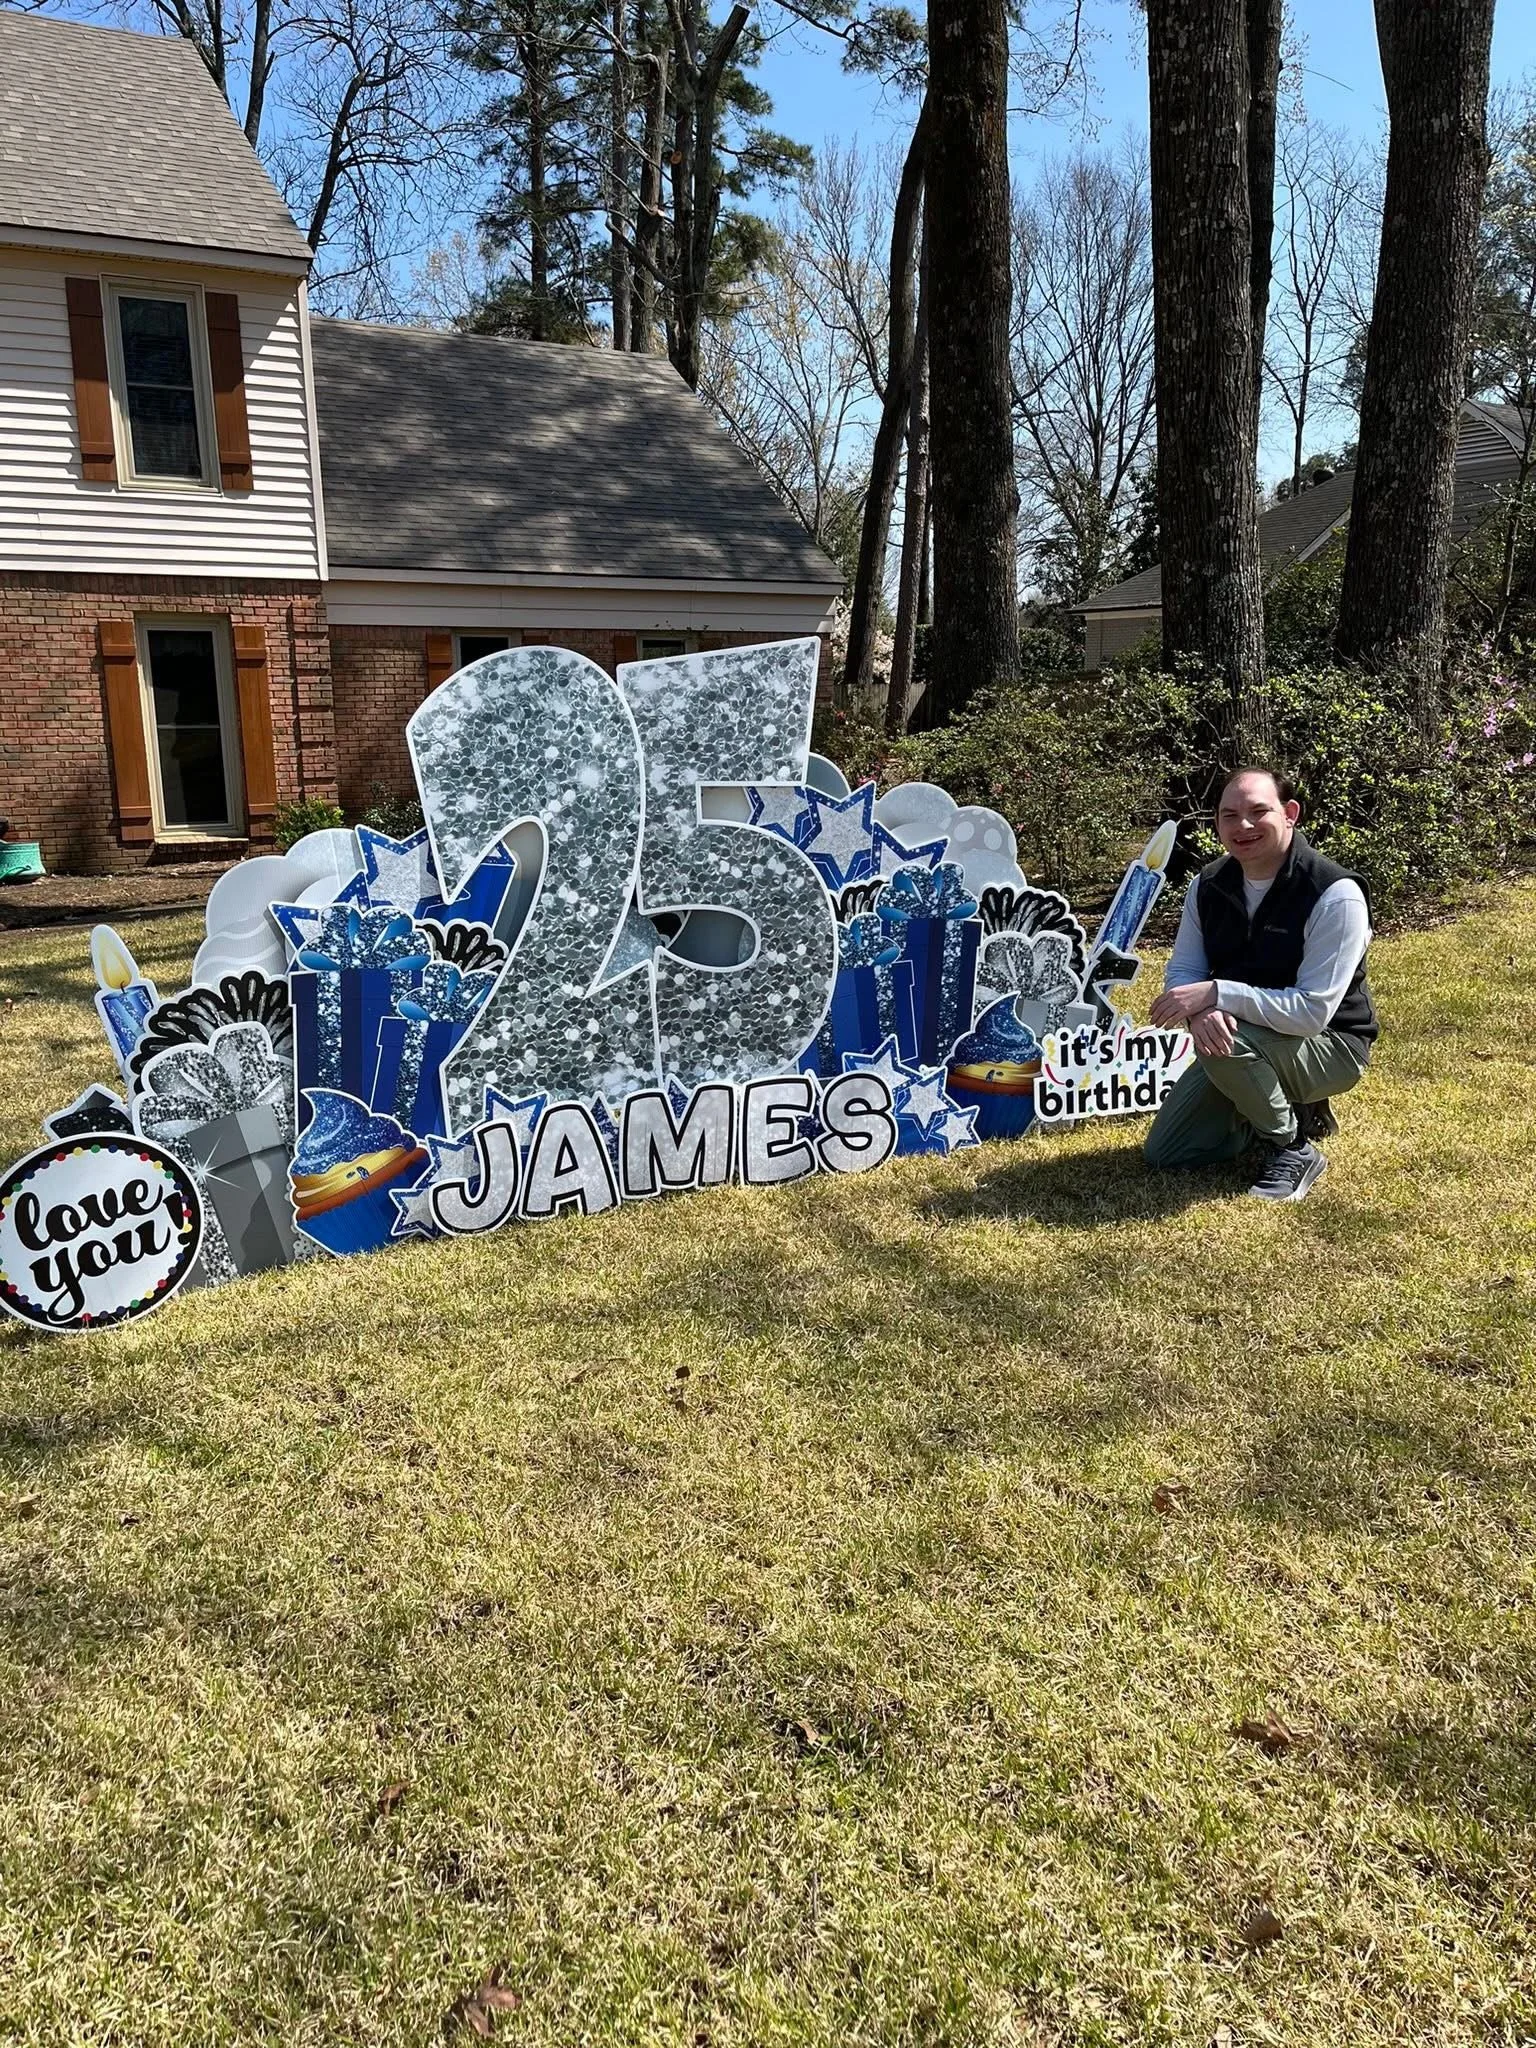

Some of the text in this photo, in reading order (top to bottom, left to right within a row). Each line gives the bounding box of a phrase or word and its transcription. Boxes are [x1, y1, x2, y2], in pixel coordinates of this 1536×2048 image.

[406, 636, 838, 1139] 25
[1060, 1031, 1179, 1068] it's my
[1039, 1069, 1176, 1117] birthda
[431, 1072, 896, 1231] JAMES
[14, 1178, 164, 1251] love
